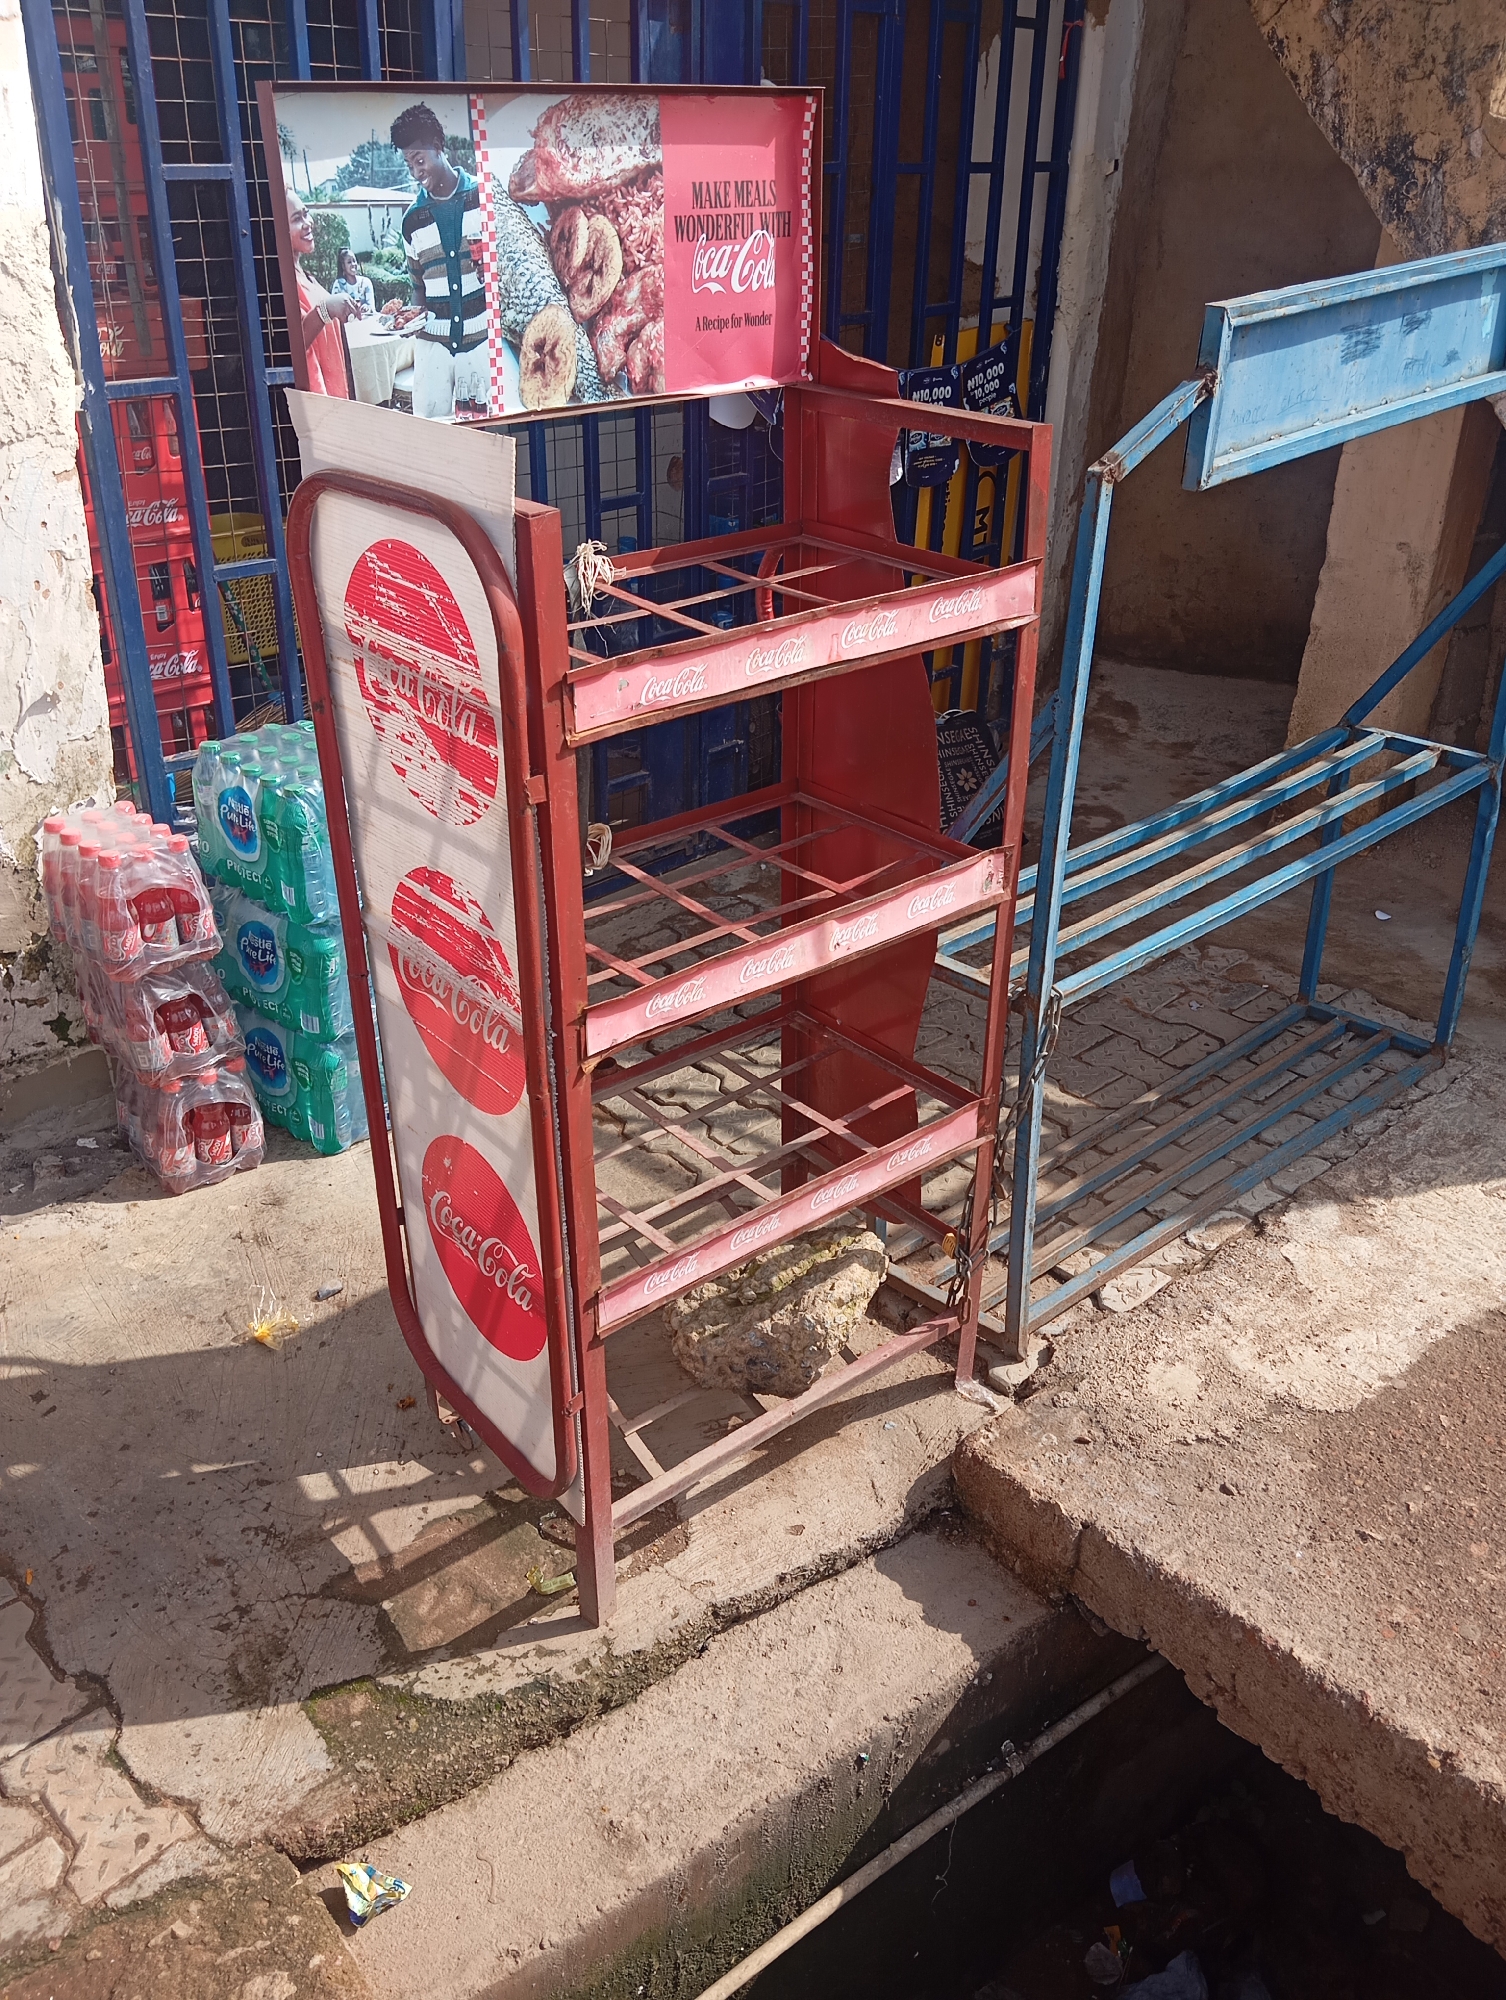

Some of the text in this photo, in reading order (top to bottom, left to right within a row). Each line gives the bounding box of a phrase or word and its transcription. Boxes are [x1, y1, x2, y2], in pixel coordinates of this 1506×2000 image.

[691, 180, 777, 210] MAKE MEALS
[674, 211, 792, 243] WONDERFUL WITH
[695, 312, 773, 333] A Recipe for Wonder
[979, 392, 997, 406] people
